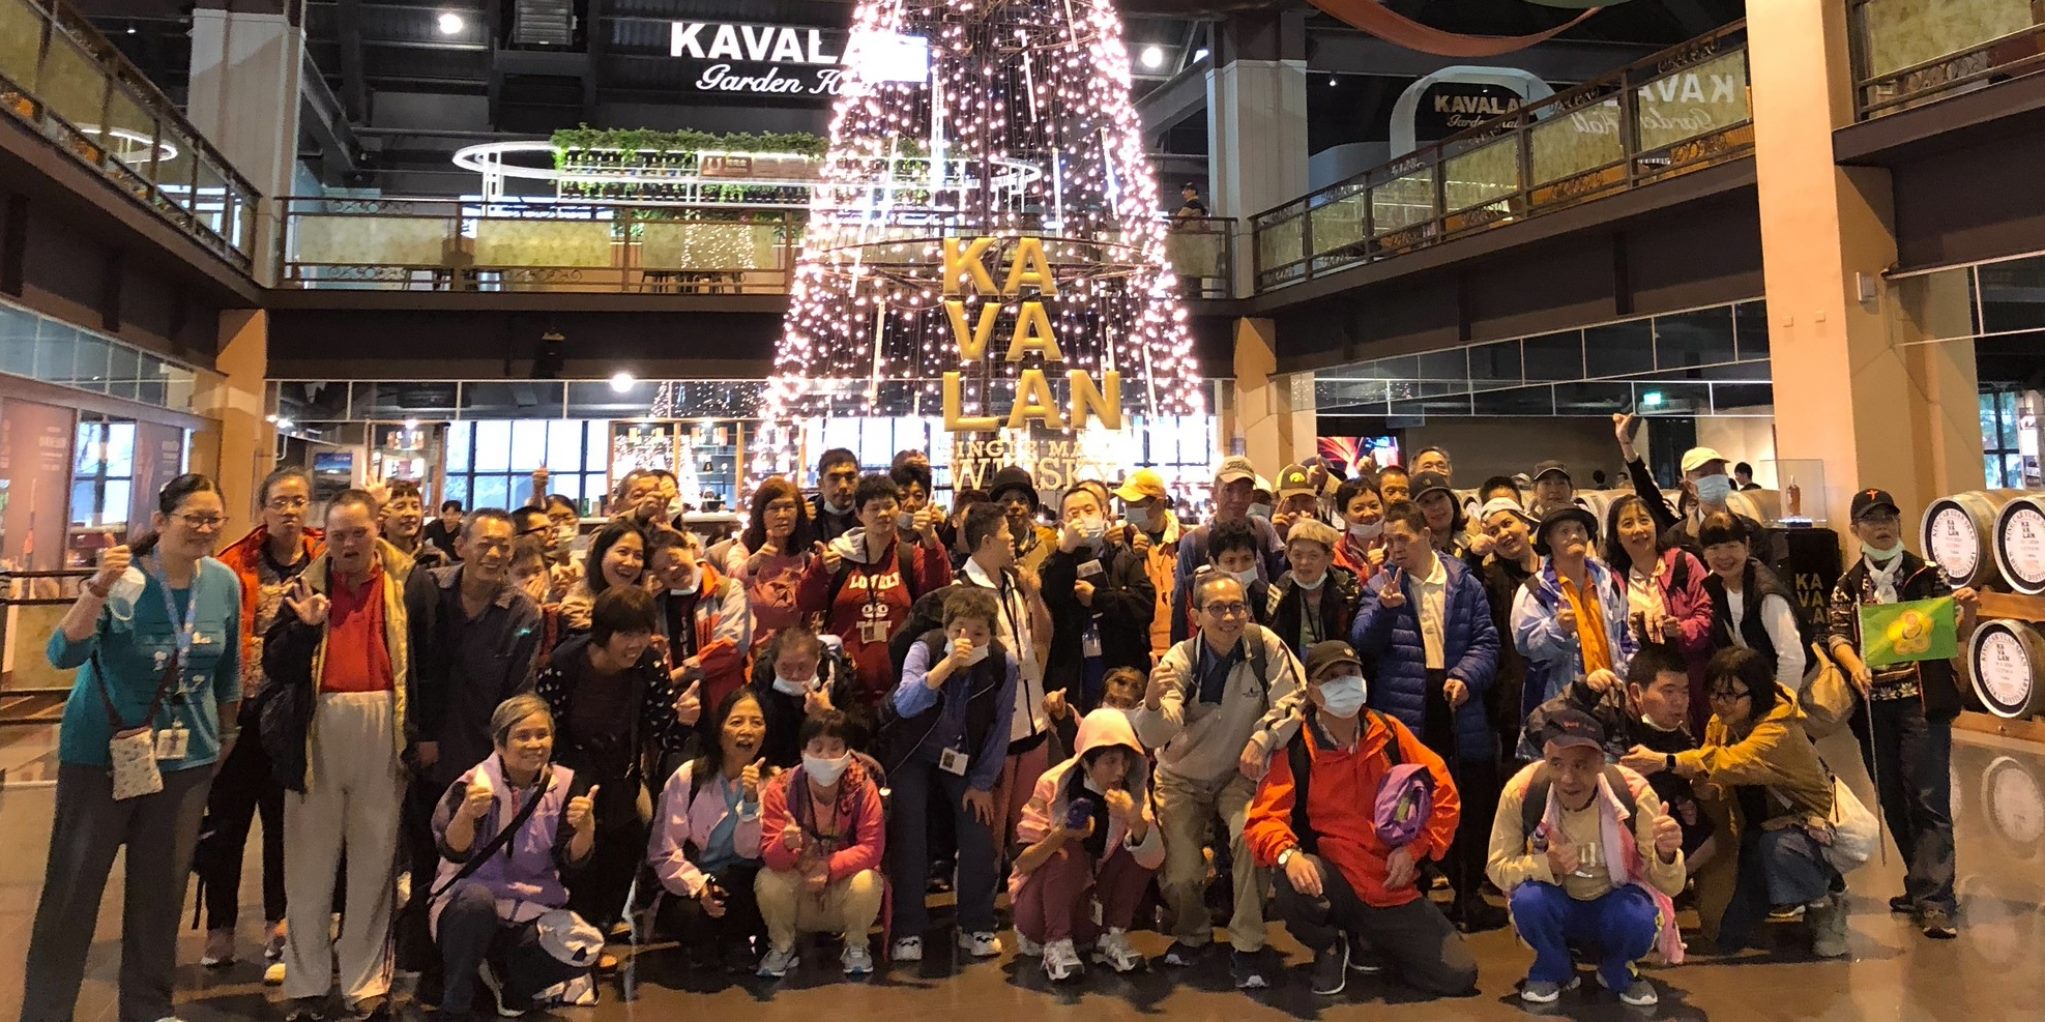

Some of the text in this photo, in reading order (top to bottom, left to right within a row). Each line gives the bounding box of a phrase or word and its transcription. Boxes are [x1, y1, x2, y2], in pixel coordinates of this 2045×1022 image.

[695, 63, 804, 94] Garden
[1434, 94, 1520, 115] KAVALA
[942, 236, 1059, 297] KA
[944, 301, 1064, 362] VA
[942, 369, 1122, 432] LAN
[1795, 572, 1824, 591] KA
[1796, 590, 1825, 608] VA
